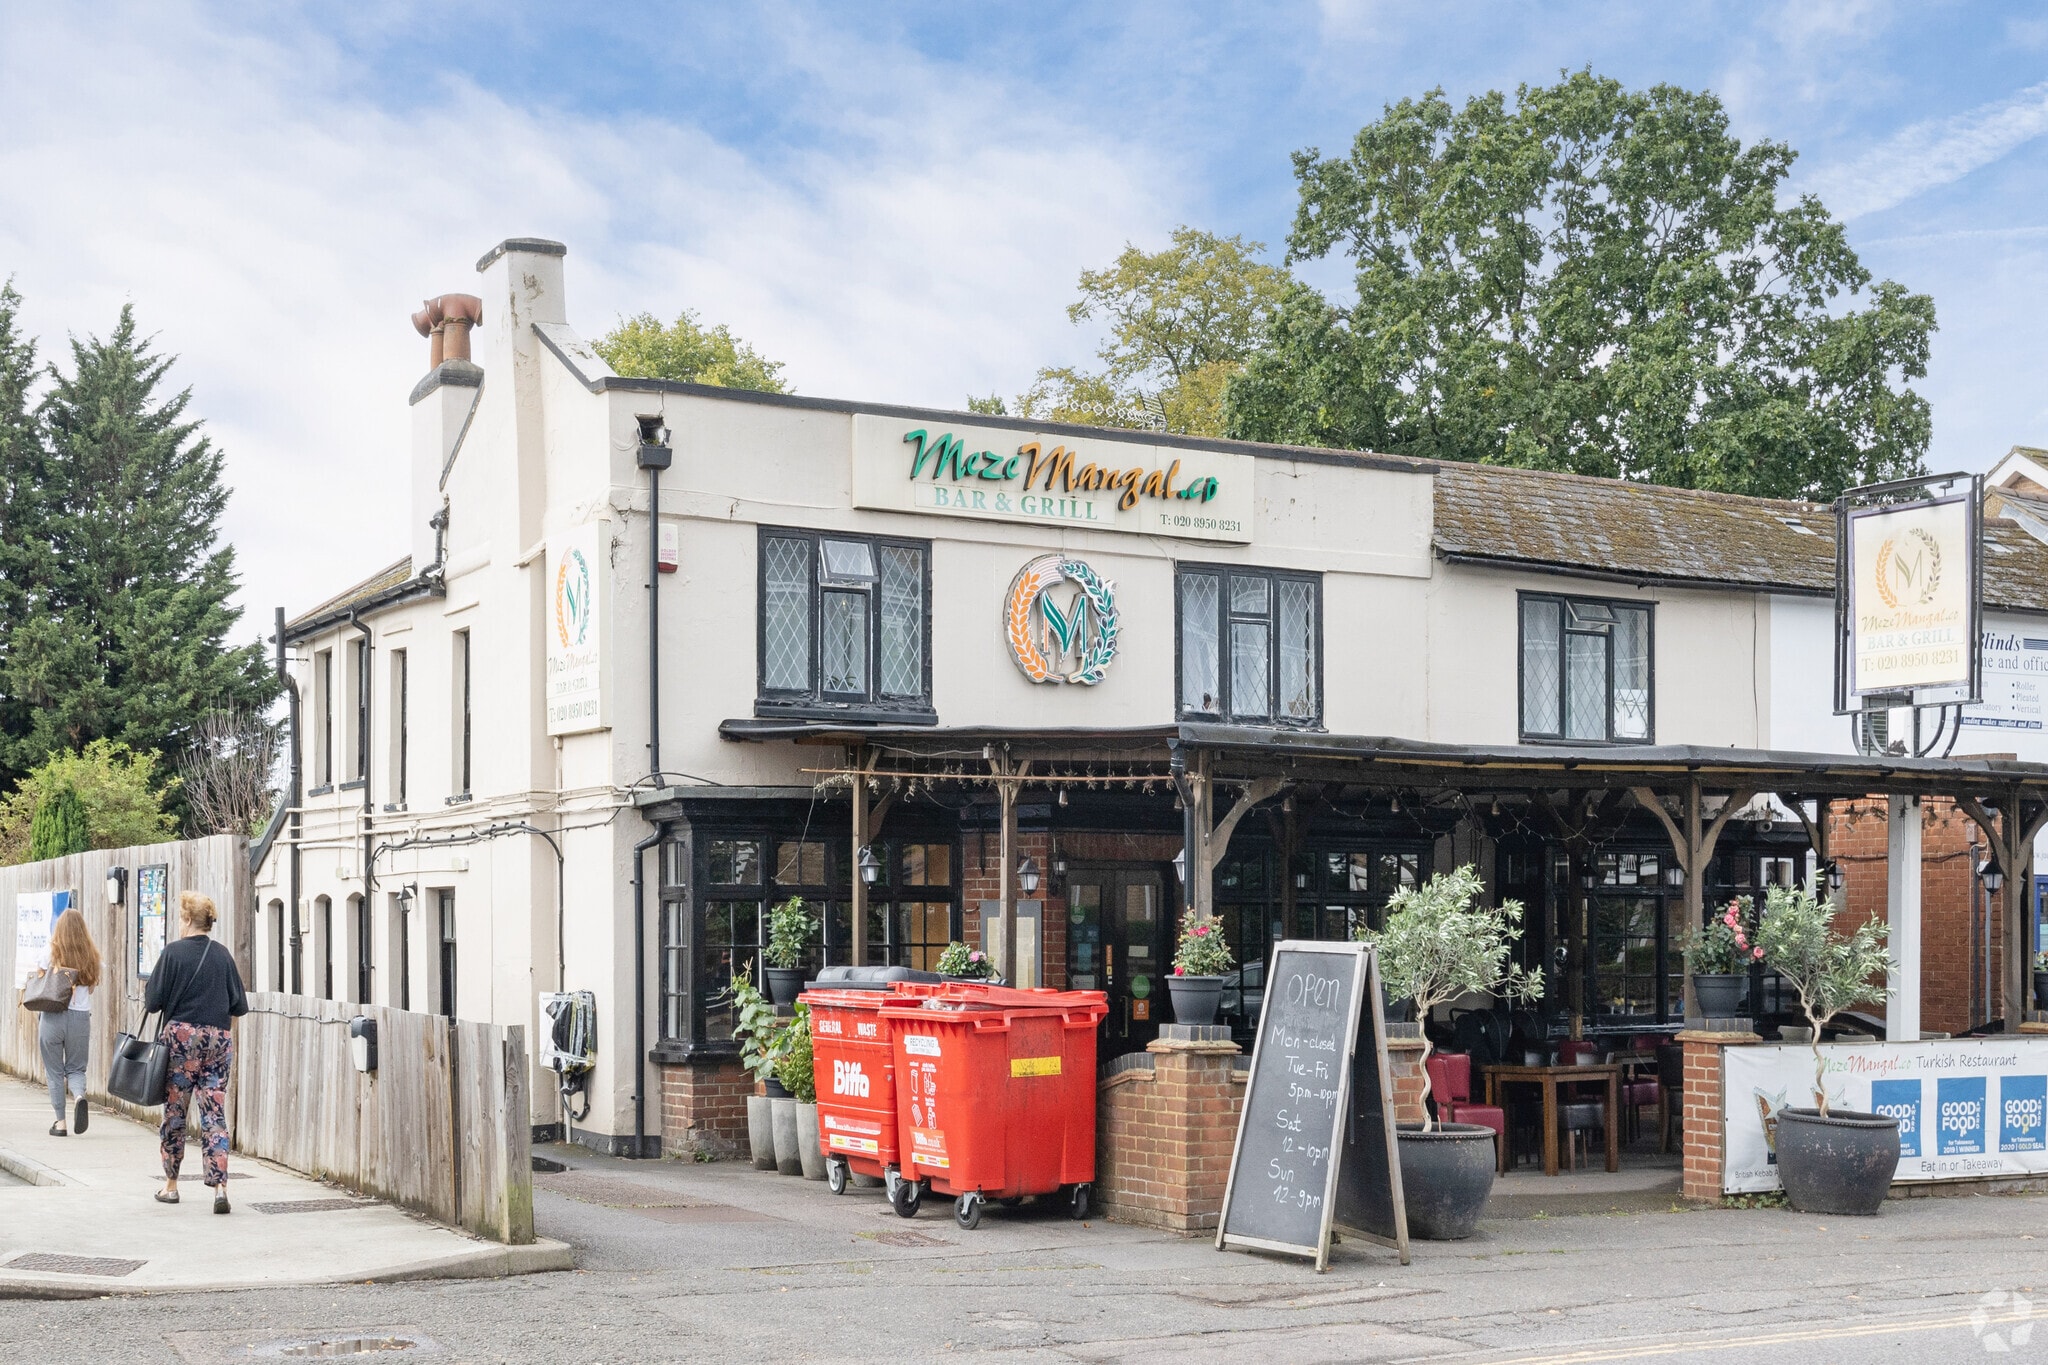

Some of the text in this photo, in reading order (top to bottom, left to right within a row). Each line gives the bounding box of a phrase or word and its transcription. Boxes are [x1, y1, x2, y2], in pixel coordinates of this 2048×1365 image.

[934, 486, 1098, 520] BAR & GRILL
[1173, 515, 1191, 528] 020
[1193, 517, 1217, 530] 8950
[1219, 518, 1241, 532] 8231
[1867, 628, 1954, 650] BAR & GRILL
[1981, 632, 2021, 652] linds
[1877, 655, 1898, 671] 020
[1900, 652, 1929, 668] 8950
[1931, 649, 1958, 665] 8231
[1998, 655, 2018, 670] and
[2016, 681, 2036, 691] Roller
[2016, 692, 2039, 703] Pleated
[2016, 704, 2041, 714] Vertical
[818, 1020, 877, 1037] GENERAL WASTE
[1915, 1053, 1956, 1069] Turkish
[1959, 1053, 2018, 1068] Restaurant
[833, 1059, 870, 1098] Biffa
[1876, 1104, 1911, 1118] GOOD
[1941, 1101, 1976, 1117] GOOD
[2005, 1099, 2038, 1114] GOOD
[1276, 1109, 1302, 1132] Sat
[1942, 1115, 1976, 1131] FOOD
[2005, 1113, 2038, 1129] FOOD
[1958, 1145, 1980, 1153] WINNER
[2000, 1142, 2045, 1151] 2020 GOLD SEAL
[1267, 1158, 1295, 1183] Sun
[1921, 1158, 2003, 1173] Eat in or Takeaway
[1735, 1170, 1754, 1179] British
[1754, 1169, 1773, 1178] Kebab
